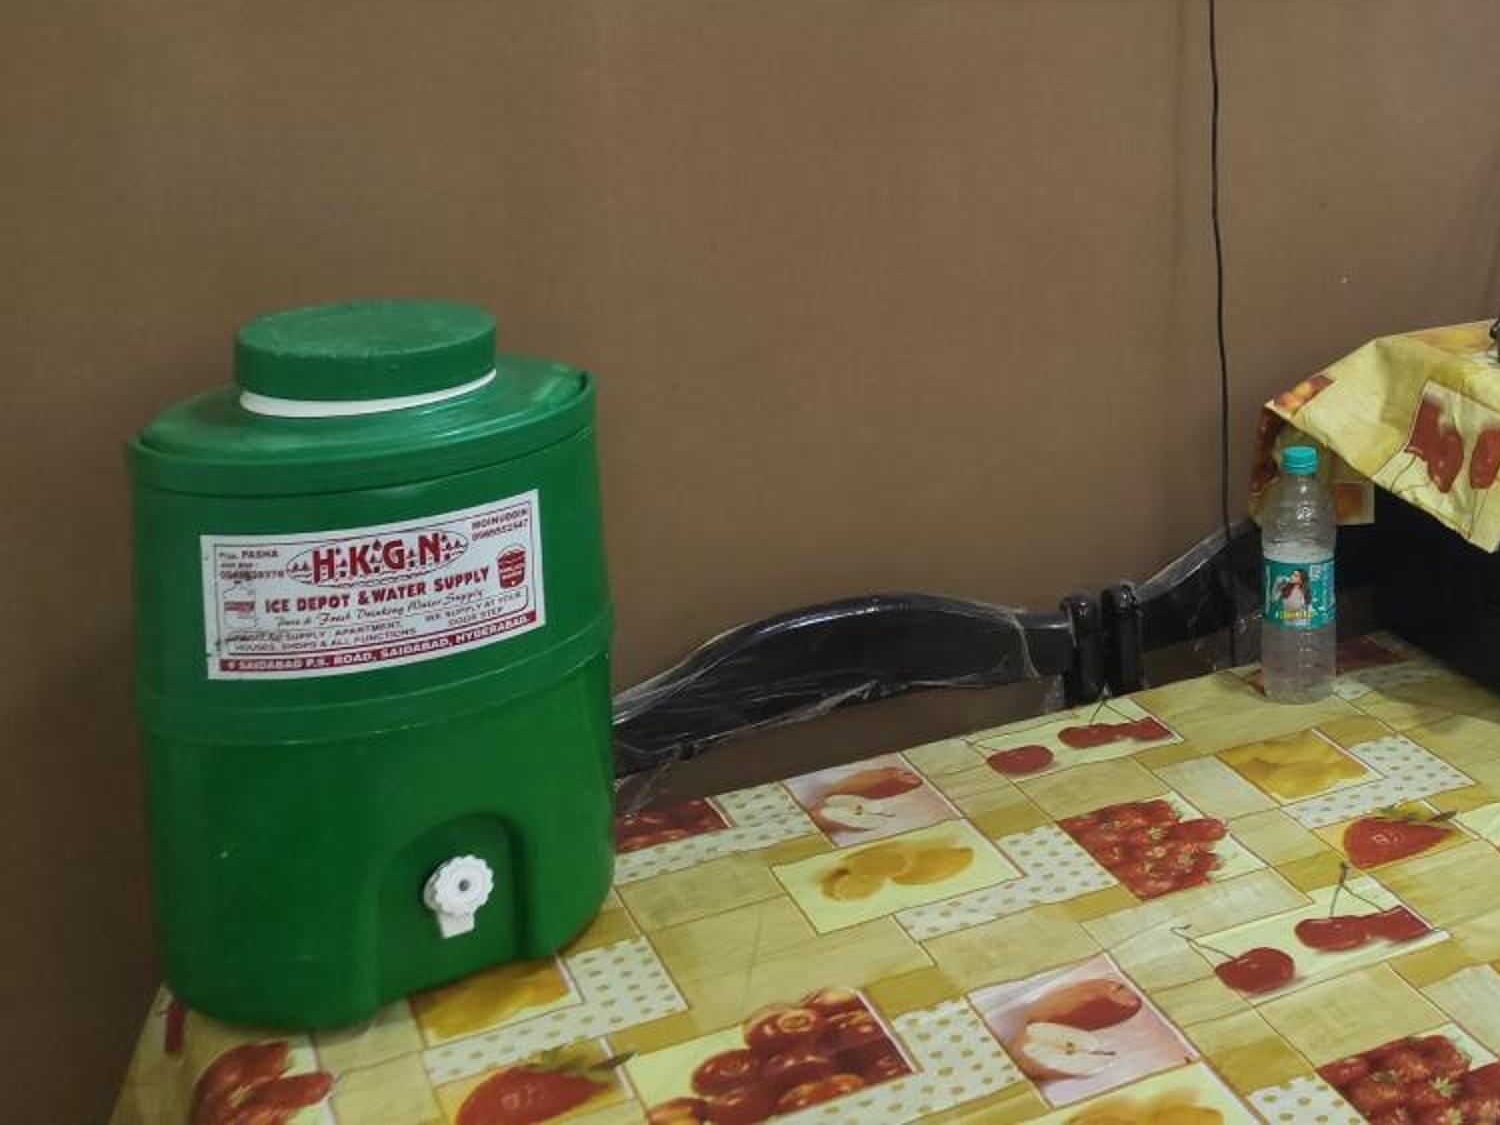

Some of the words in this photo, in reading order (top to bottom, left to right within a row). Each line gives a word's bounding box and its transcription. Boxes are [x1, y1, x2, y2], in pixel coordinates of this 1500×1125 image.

[264, 598, 290, 614] ICE
[296, 593, 351, 612] DEPOT
[357, 589, 369, 606] &
[371, 581, 427, 604] WATER
[433, 565, 490, 593] SUPPLY
